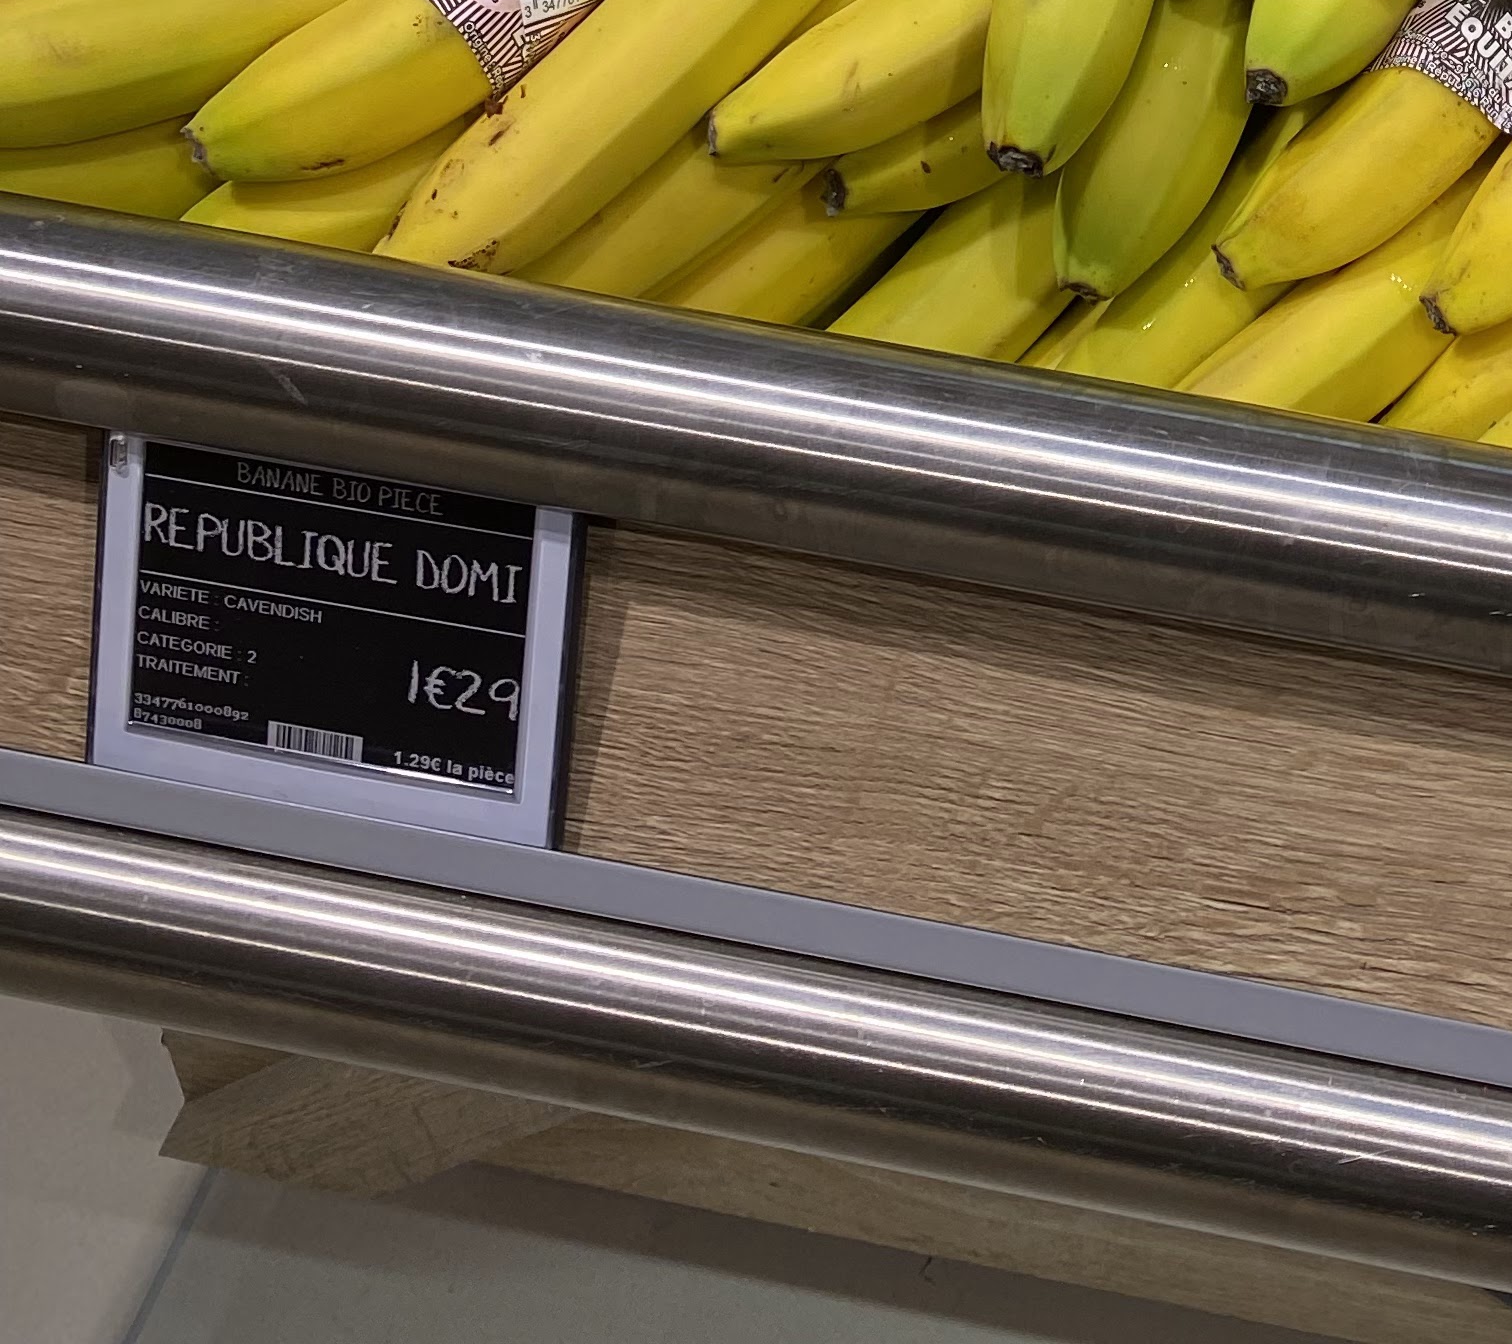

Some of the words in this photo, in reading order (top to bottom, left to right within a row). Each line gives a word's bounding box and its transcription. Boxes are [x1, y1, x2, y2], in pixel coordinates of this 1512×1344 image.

[524, 5, 533, 19] 3
[237, 461, 324, 496] BANANE
[332, 477, 371, 503] BIO
[378, 485, 444, 516] PIECE
[144, 501, 398, 586] REPUBLIQUE
[415, 549, 523, 604] DOMI
[137, 605, 212, 631] CALIBRE
[139, 579, 211, 605] VARIETE
[223, 594, 323, 624] CAVENDISH
[136, 630, 234, 661] CATEGORIE
[246, 650, 258, 664] 2
[136, 653, 241, 685] TRAITEMENT
[133, 692, 250, 722] 3347761000892
[407, 659, 520, 722] 1€29
[393, 750, 442, 772] 1.29€
[446, 759, 464, 776] la
[467, 765, 515, 785] pièce
